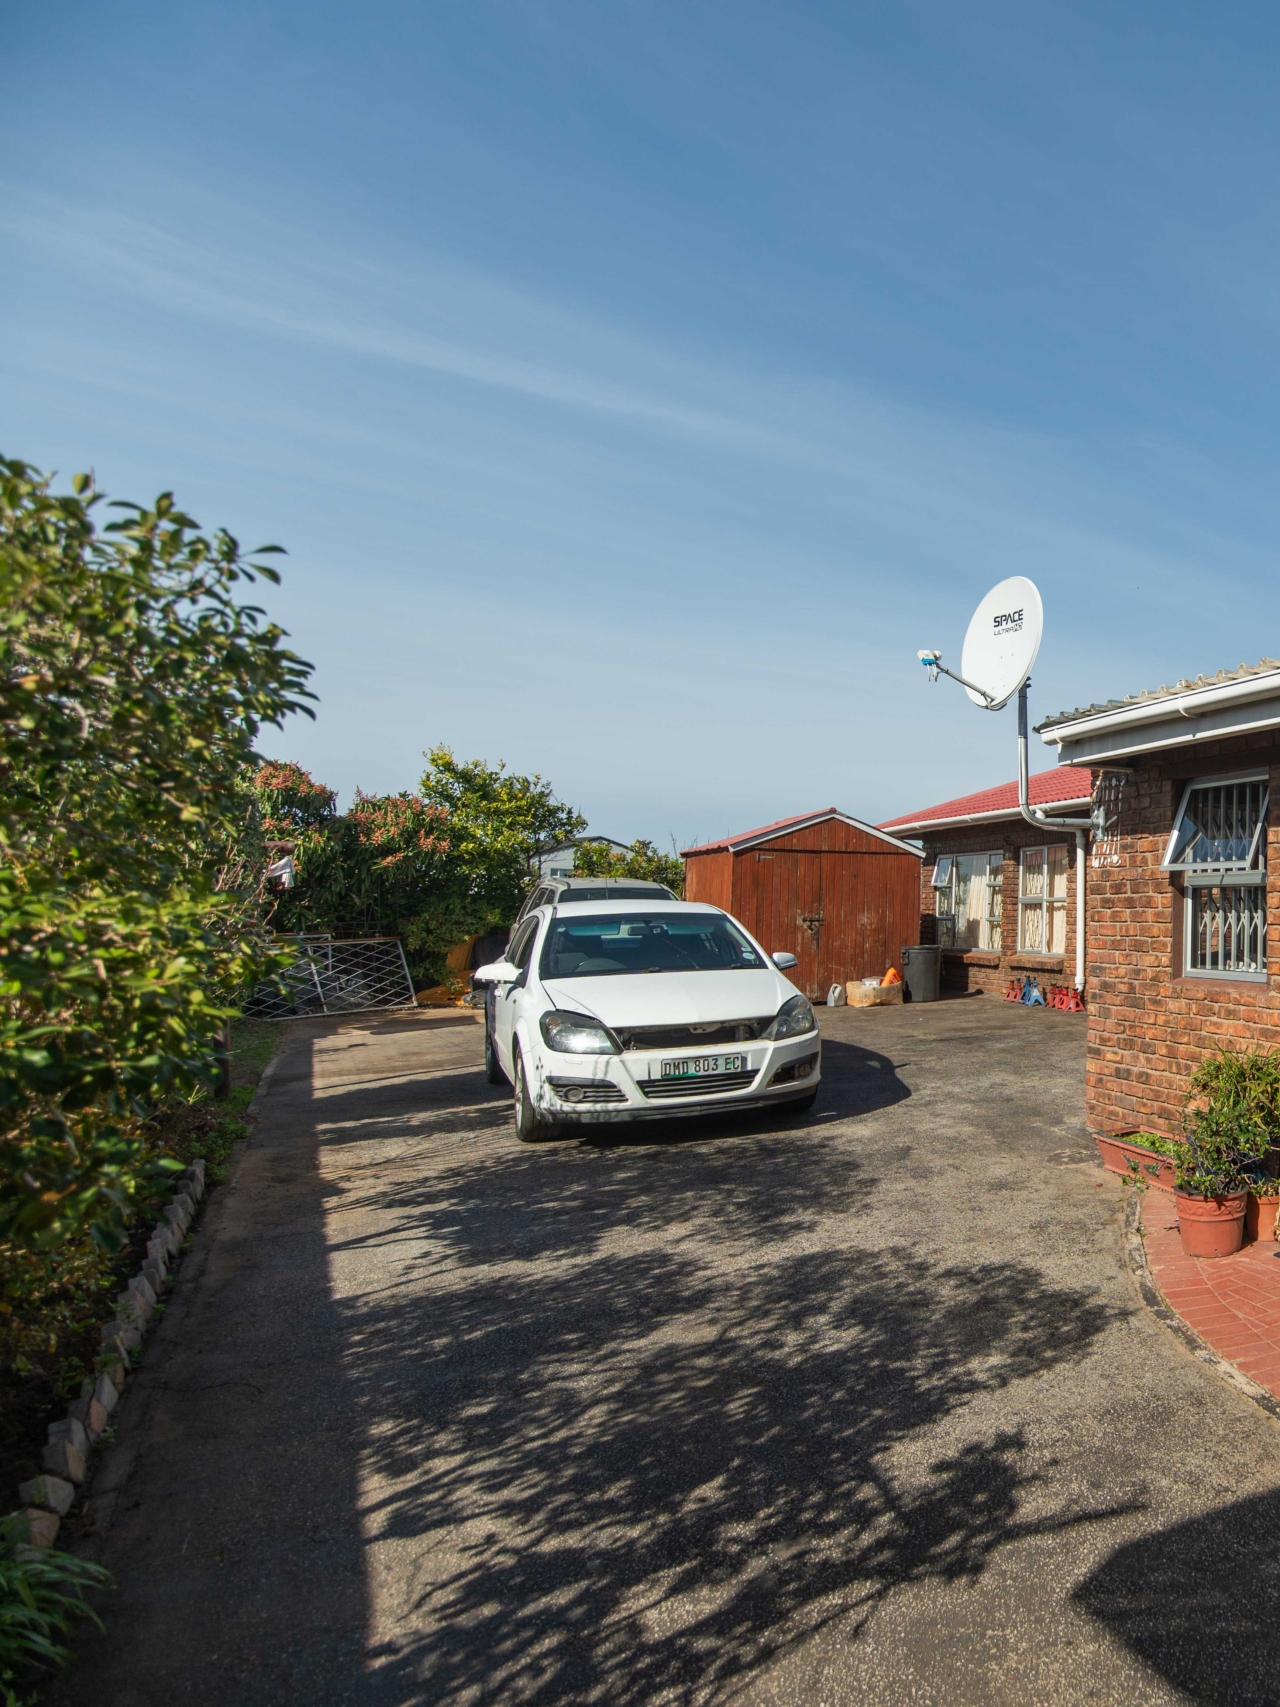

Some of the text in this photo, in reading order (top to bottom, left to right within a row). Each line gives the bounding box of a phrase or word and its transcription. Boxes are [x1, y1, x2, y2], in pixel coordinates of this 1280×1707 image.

[993, 608, 1024, 628] SPACE
[663, 1056, 740, 1077] DMD 803 EC
